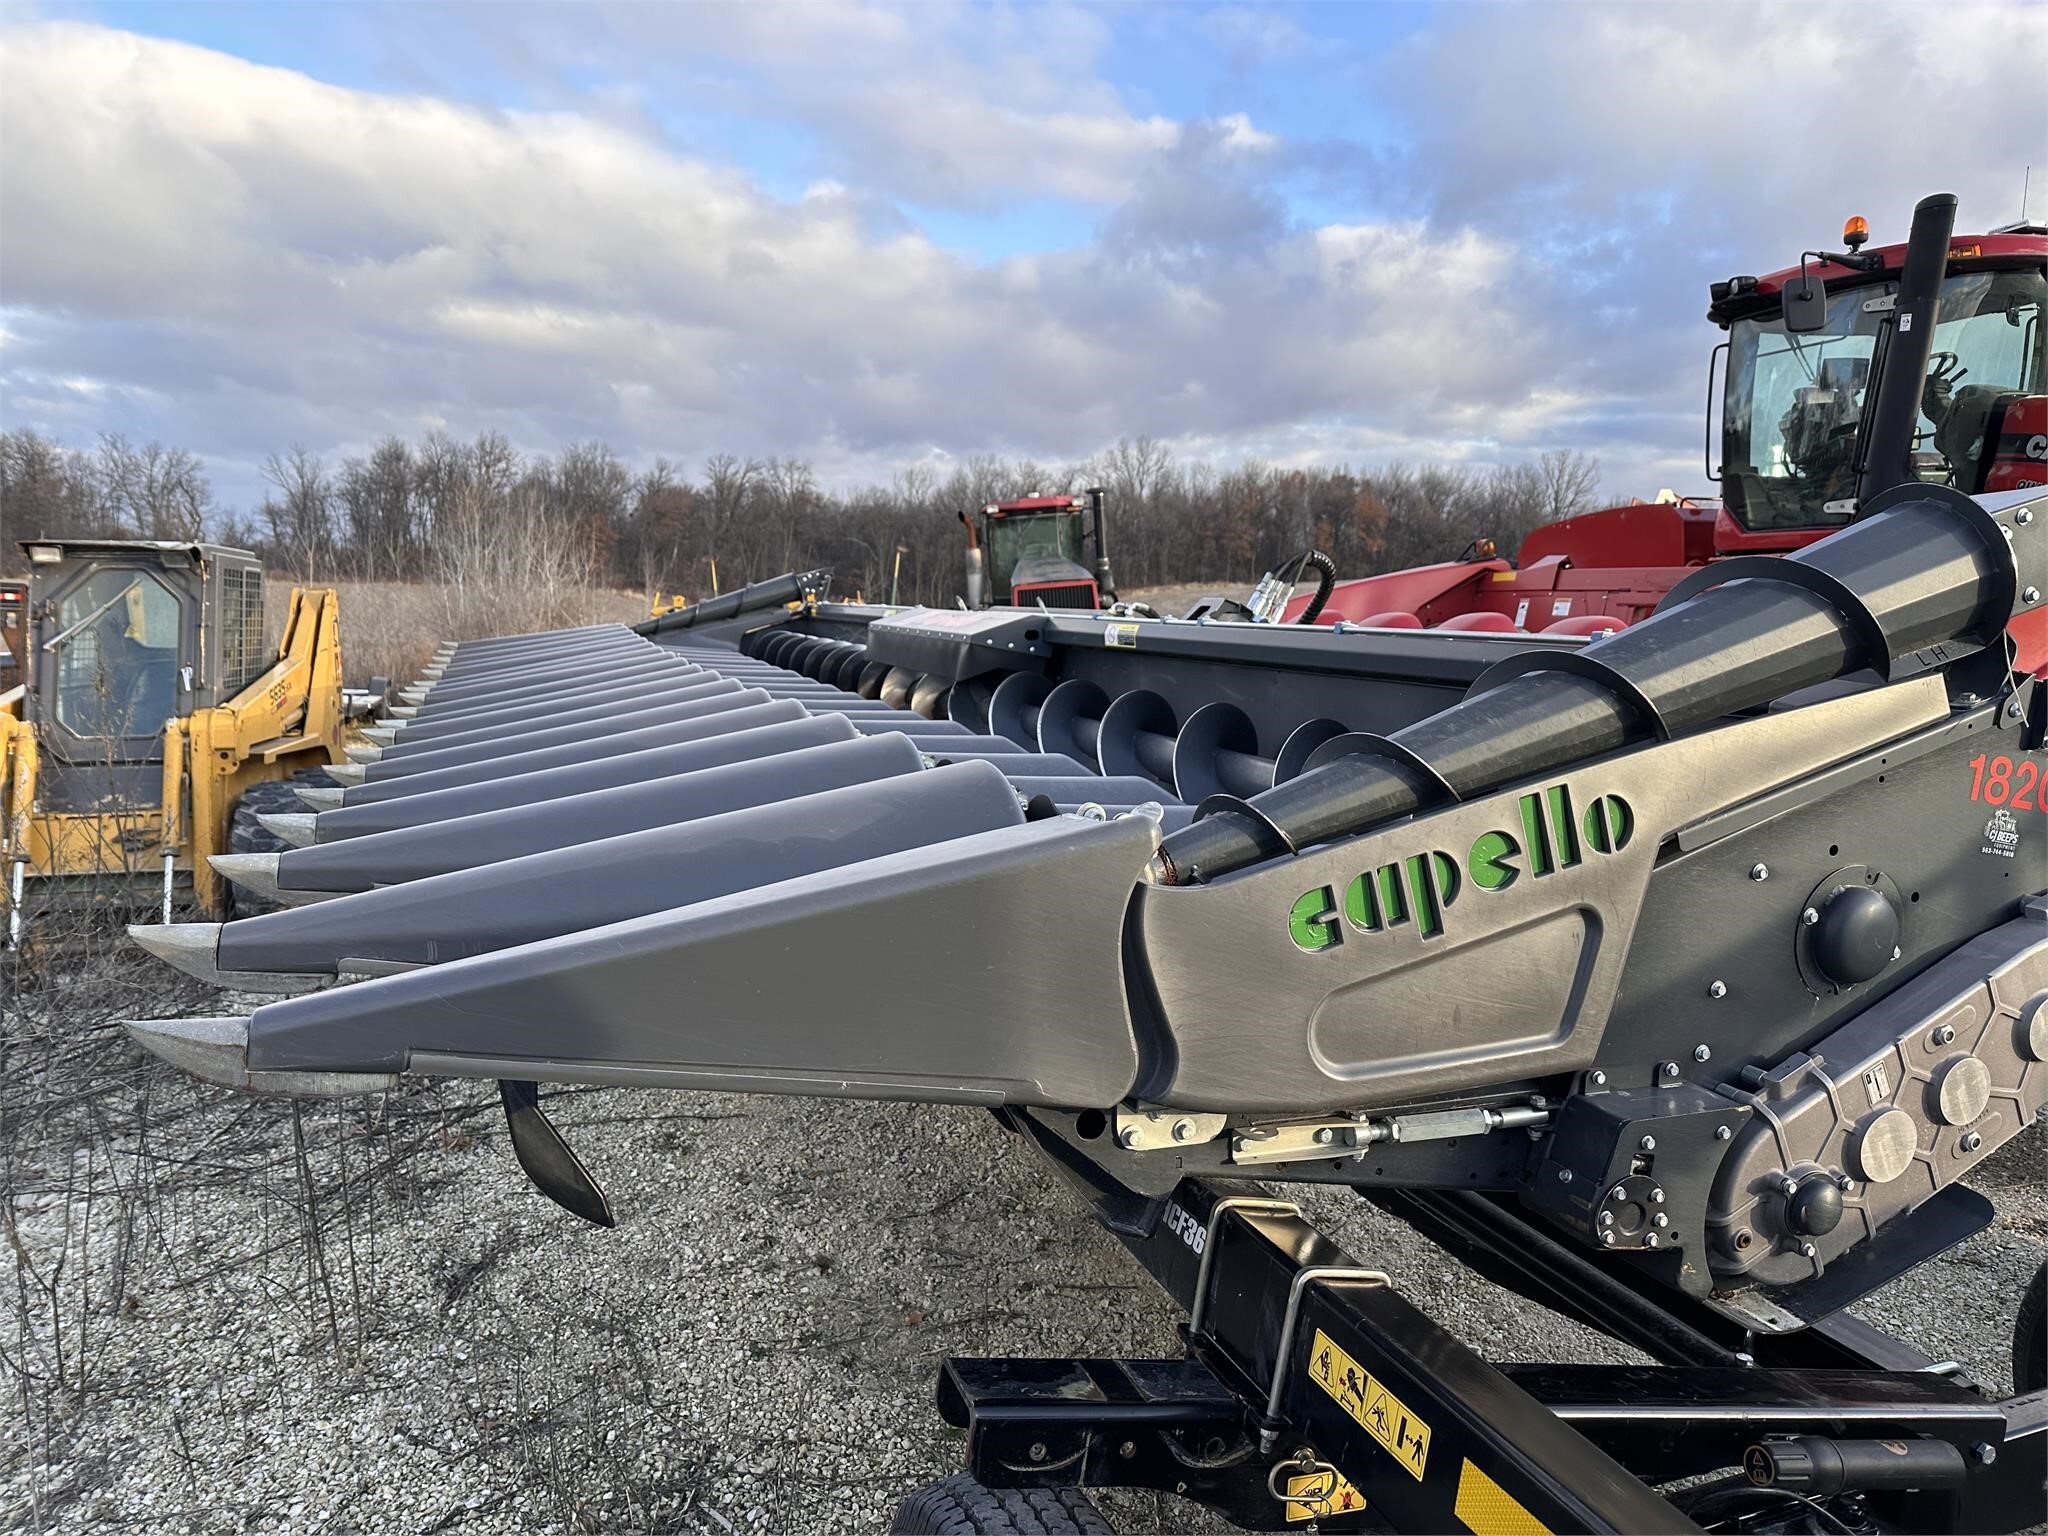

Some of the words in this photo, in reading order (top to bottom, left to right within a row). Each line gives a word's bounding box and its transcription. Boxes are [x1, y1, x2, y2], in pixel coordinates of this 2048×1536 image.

[1915, 645, 1949, 666] LH
[1997, 831, 2019, 844] BEEPS
[1288, 783, 1635, 954] capello
